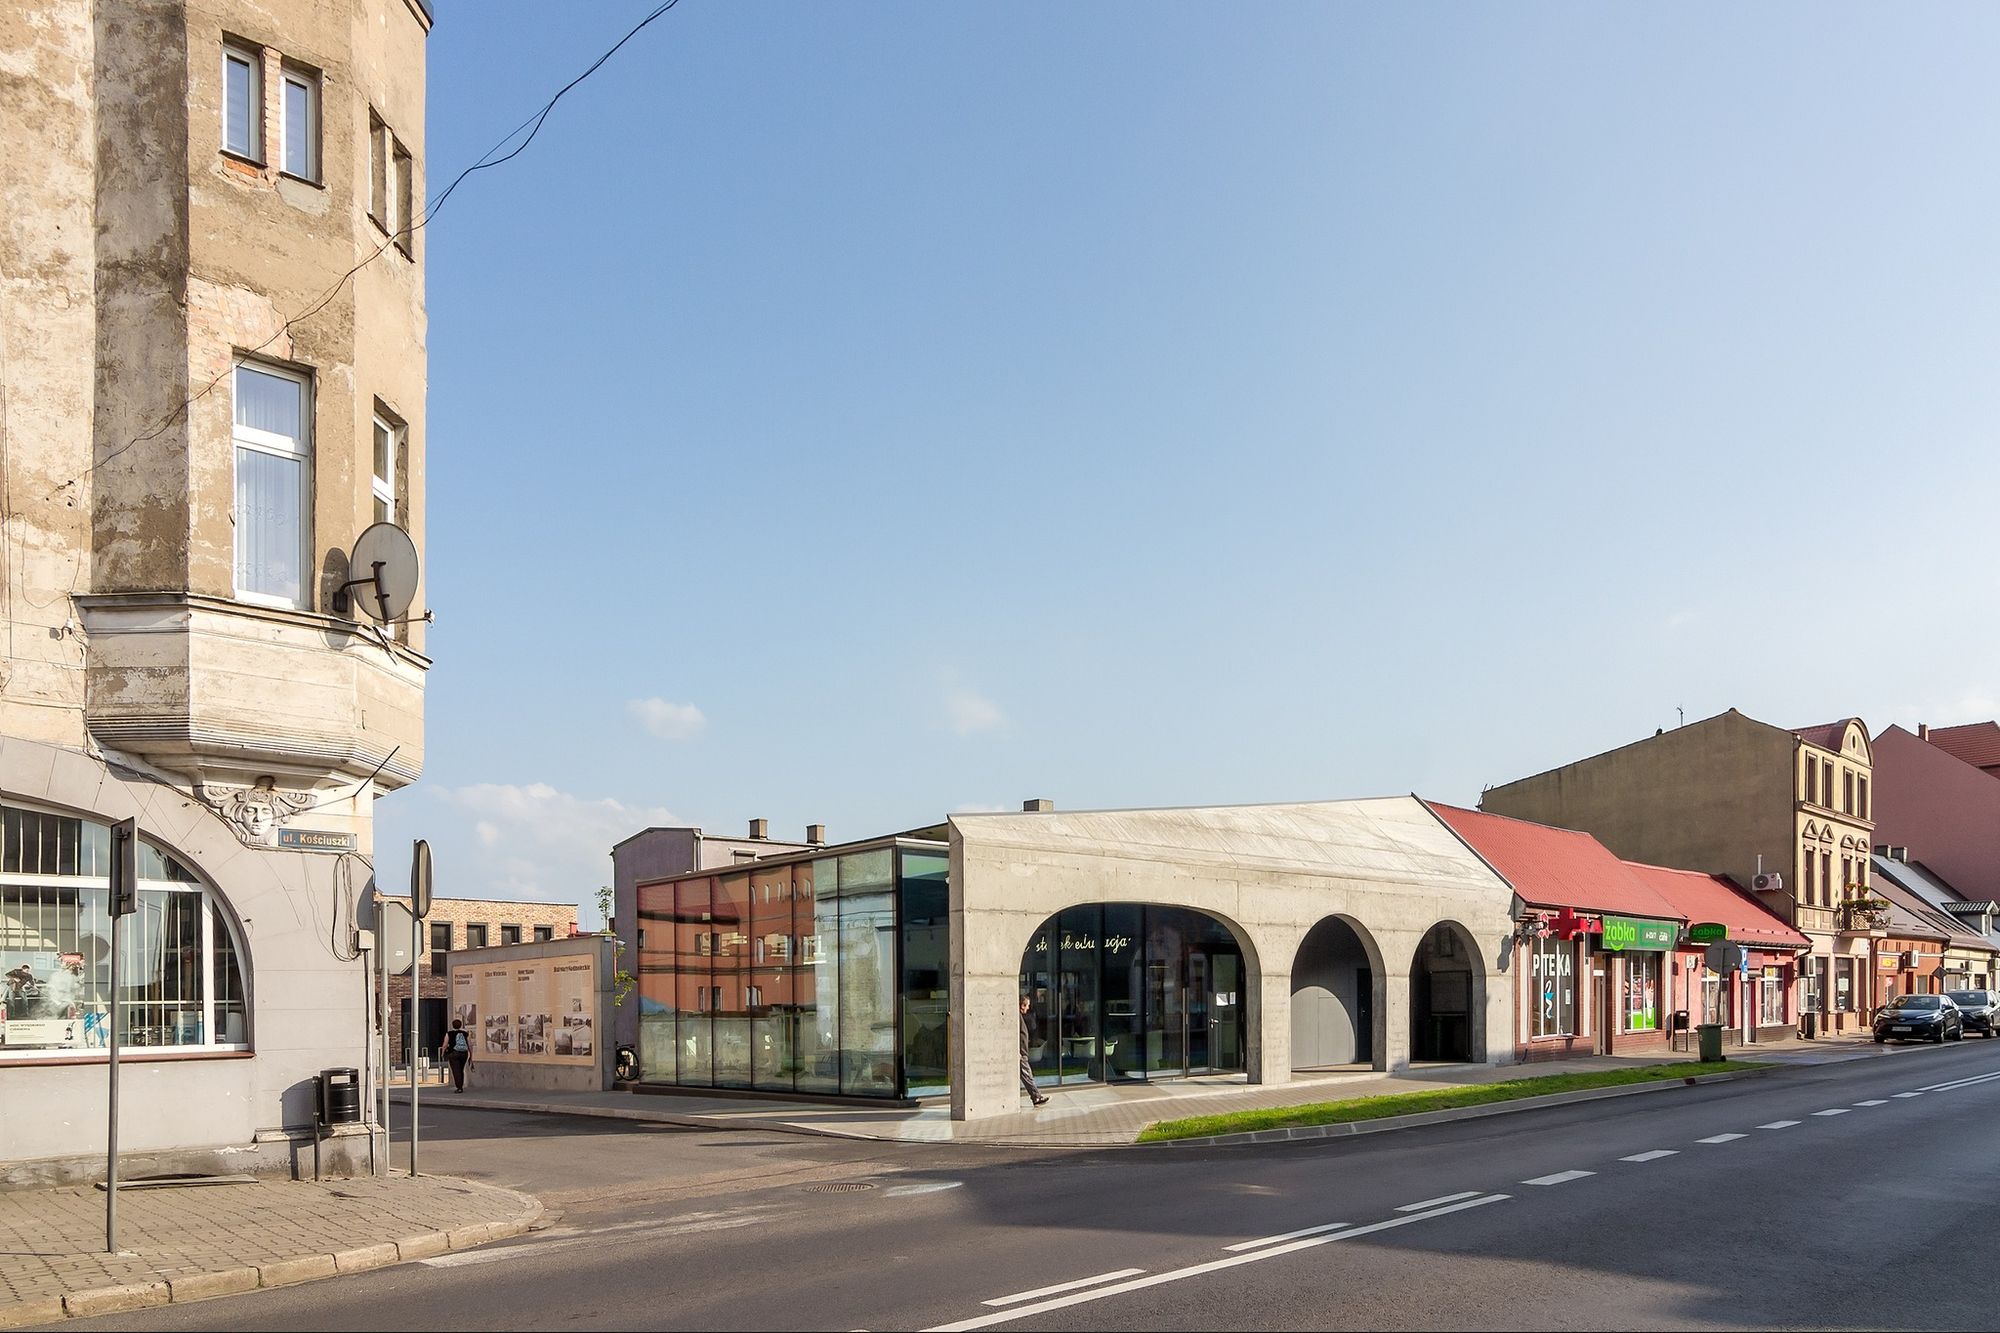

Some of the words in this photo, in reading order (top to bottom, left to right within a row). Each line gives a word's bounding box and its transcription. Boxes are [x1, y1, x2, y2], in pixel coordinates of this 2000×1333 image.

[283, 833, 296, 843] ul.
[300, 832, 350, 847] Kościuszki
[1605, 920, 1636, 942] żabka
[1074, 934, 1128, 954] educja
[1531, 953, 1571, 977] PTEKA
